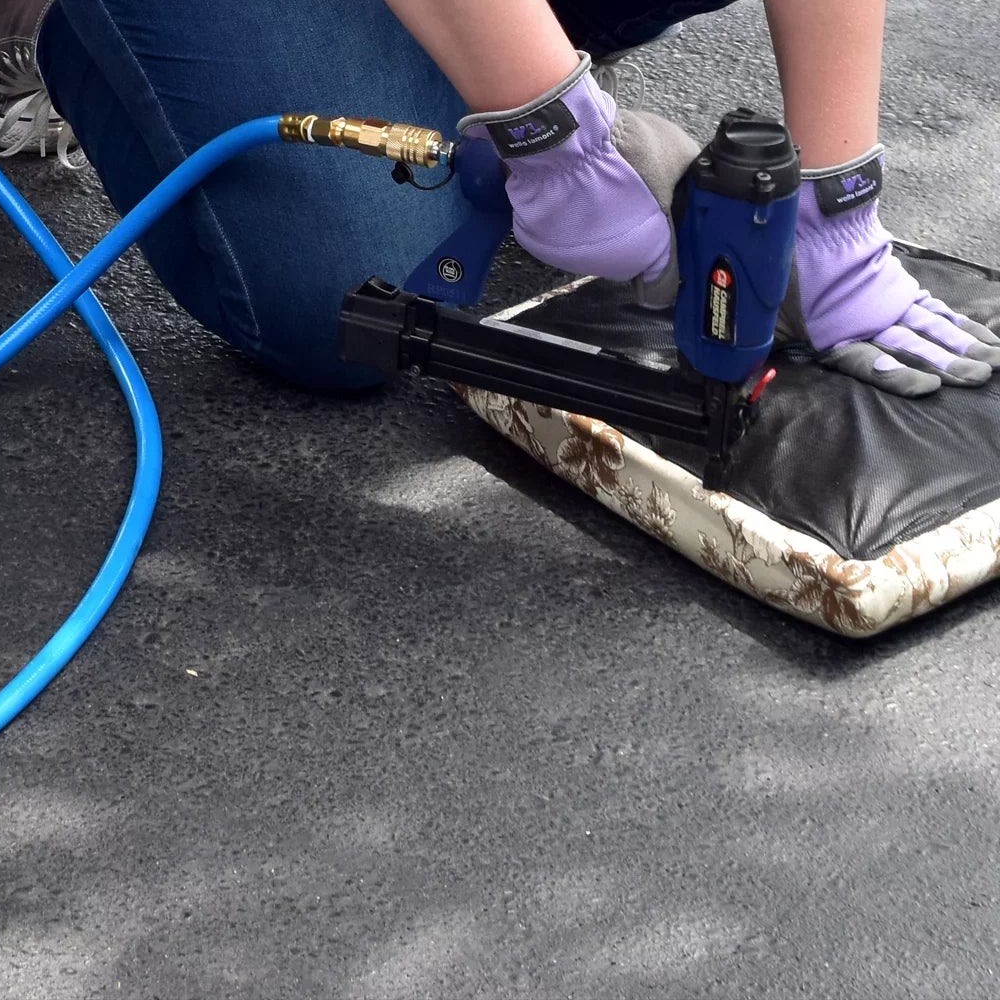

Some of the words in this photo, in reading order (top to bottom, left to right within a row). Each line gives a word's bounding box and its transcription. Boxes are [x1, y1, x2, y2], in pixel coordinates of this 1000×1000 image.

[508, 140, 528, 149] wells
[712, 286, 720, 336] HAUSFELD
[719, 290, 727, 340] CAMPBELL
